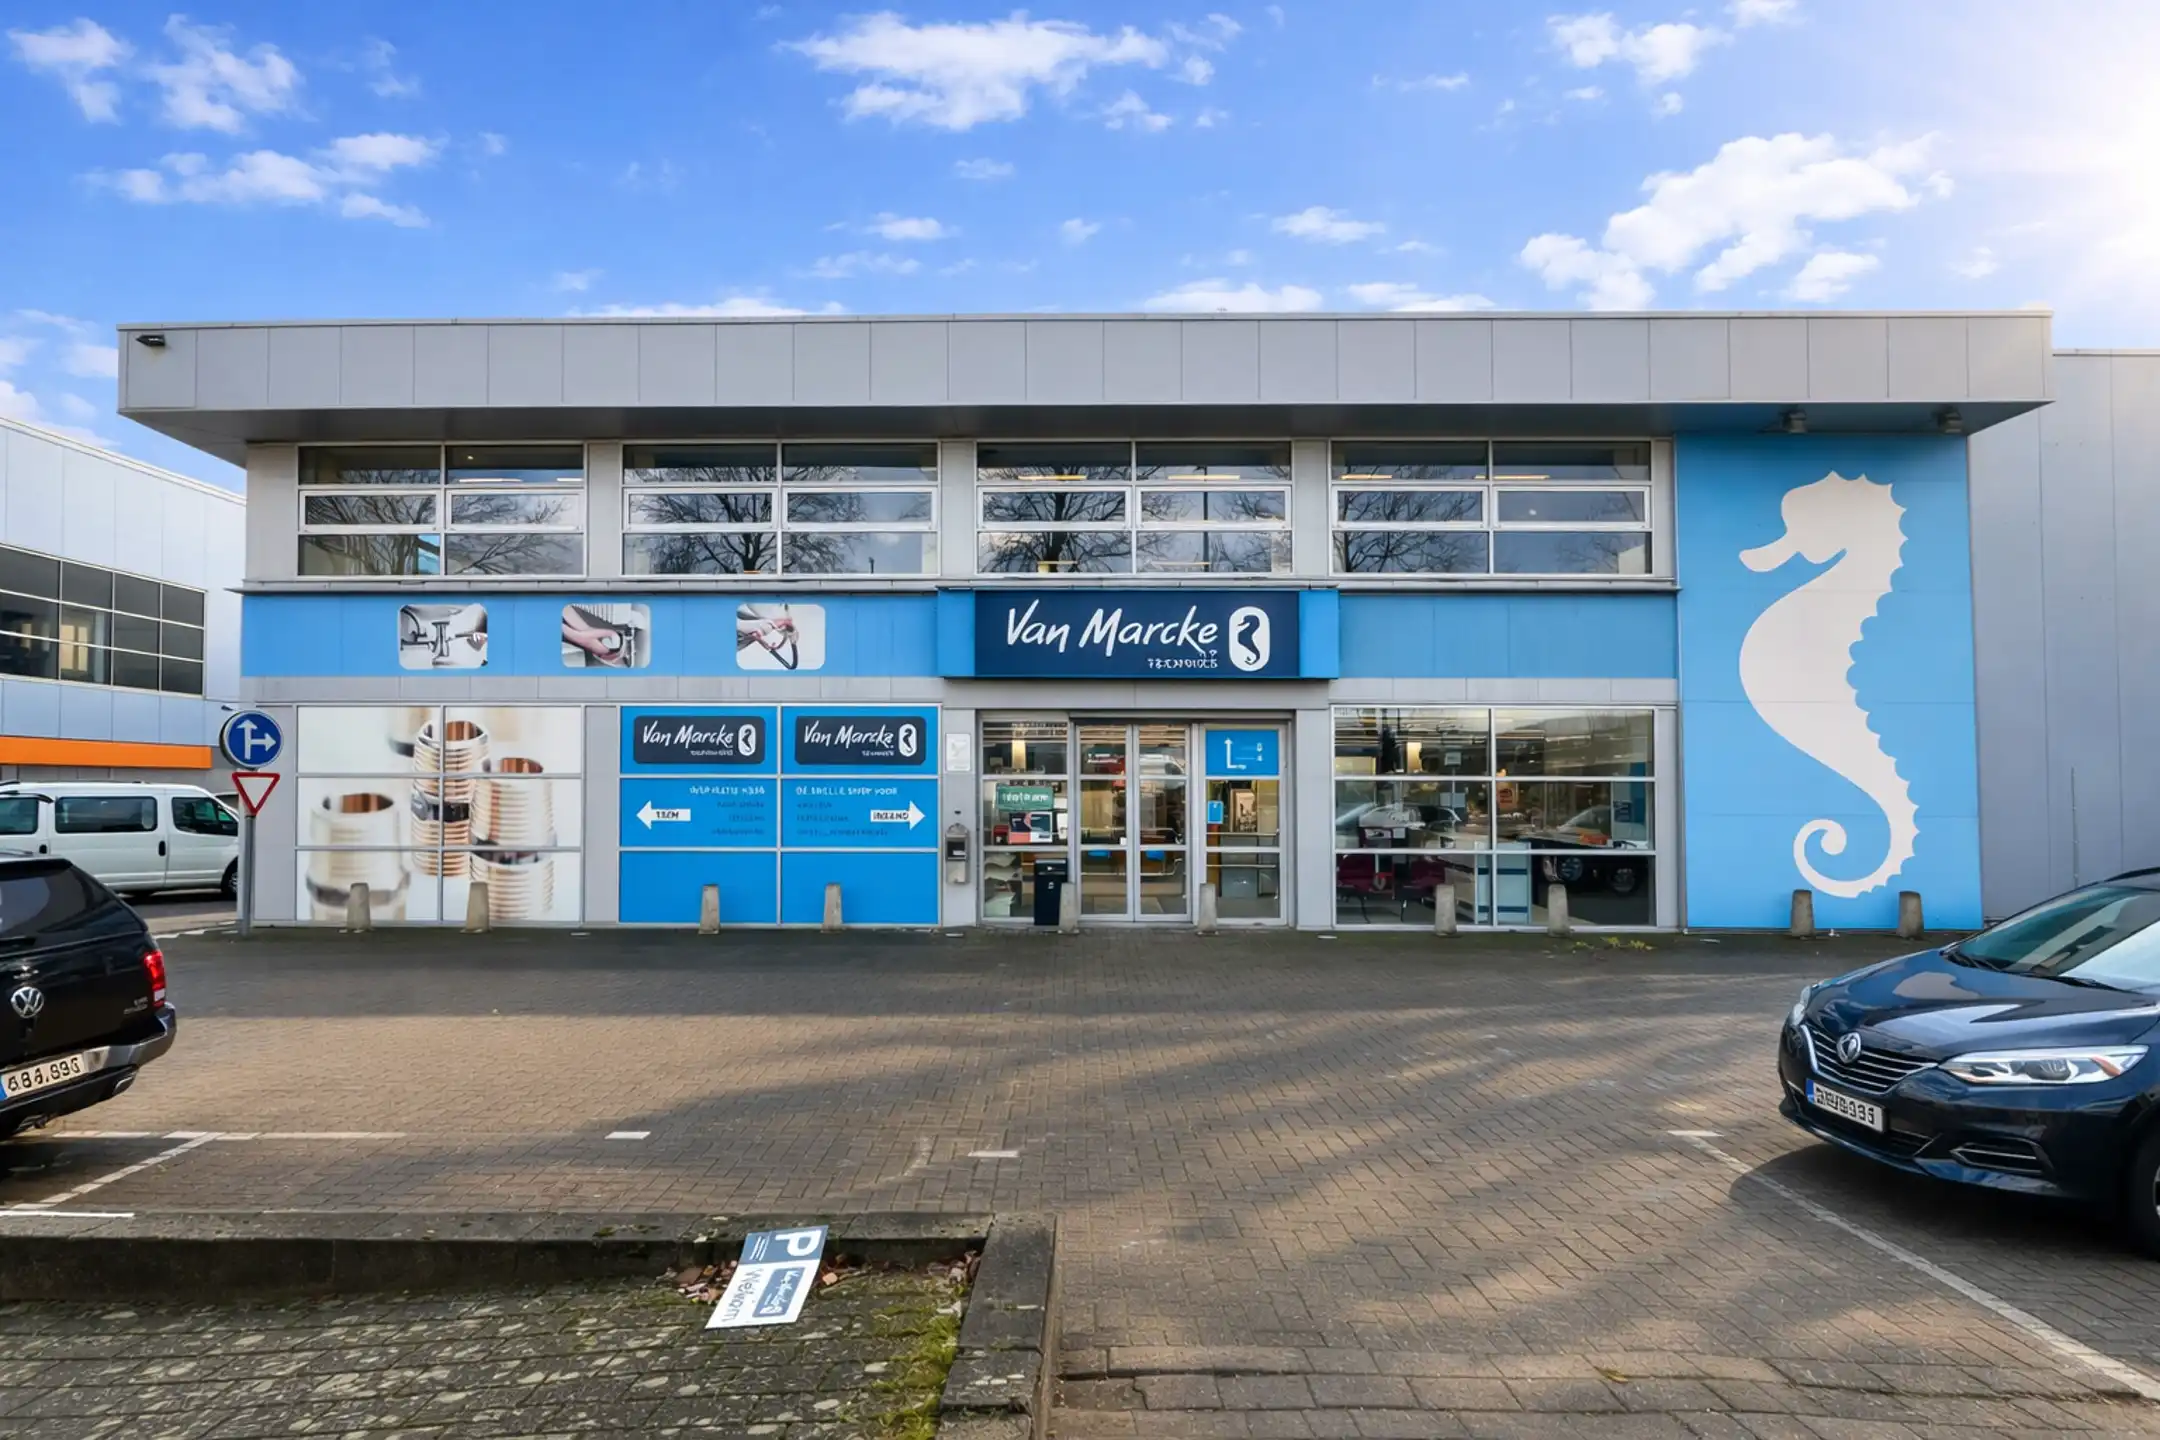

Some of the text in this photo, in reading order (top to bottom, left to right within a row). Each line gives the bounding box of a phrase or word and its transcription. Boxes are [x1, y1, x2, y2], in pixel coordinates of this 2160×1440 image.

[1006, 599, 1219, 657] Van Marcke
[643, 720, 672, 747] Van
[775, 1229, 822, 1257] P
